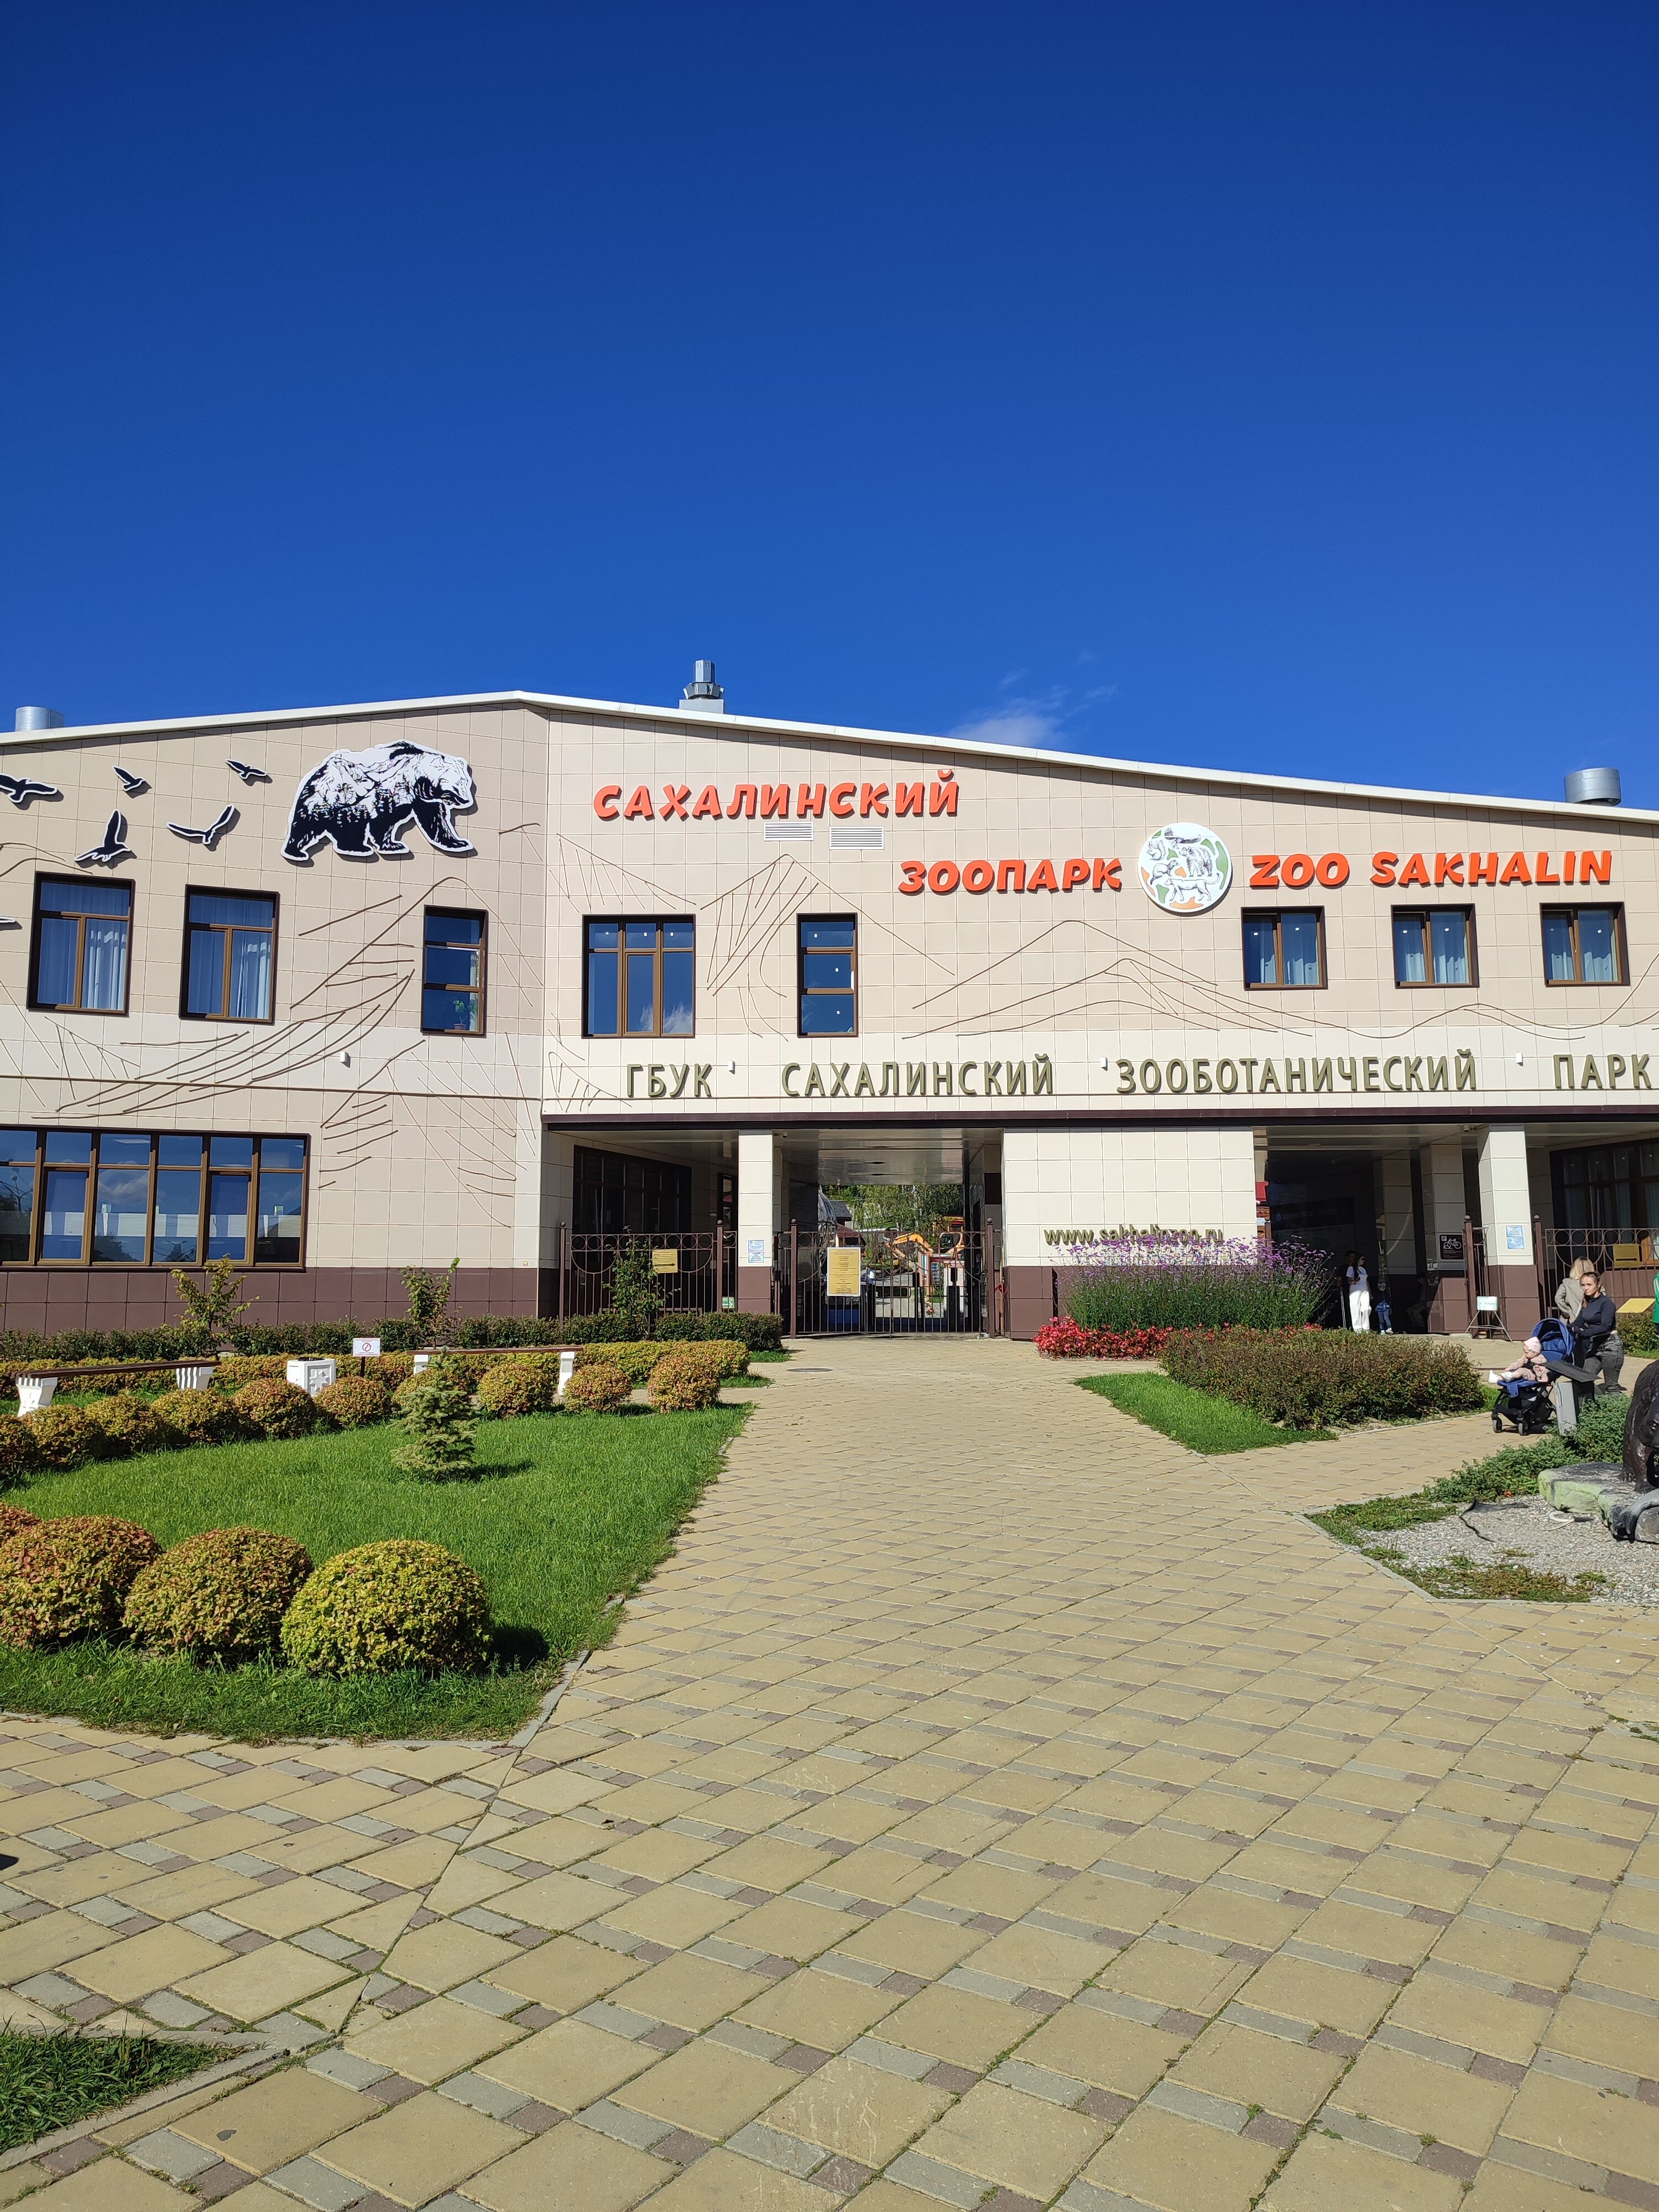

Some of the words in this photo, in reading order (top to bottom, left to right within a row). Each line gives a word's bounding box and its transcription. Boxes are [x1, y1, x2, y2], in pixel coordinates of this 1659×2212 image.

[593, 769, 959, 820] САХАЛИНСКИЙ
[899, 858, 1122, 894] ЗООПАРК
[1249, 852, 1350, 888] ZOO
[1371, 850, 1612, 886] SAKHALIN
[627, 1063, 714, 1098] ГБУК
[781, 1053, 1054, 1097] САХАЛИНСКИЙ
[1116, 1048, 1477, 1094] ЗООБОТАНИЧЕСКИЙ
[1553, 1053, 1652, 1091] ПАРК
